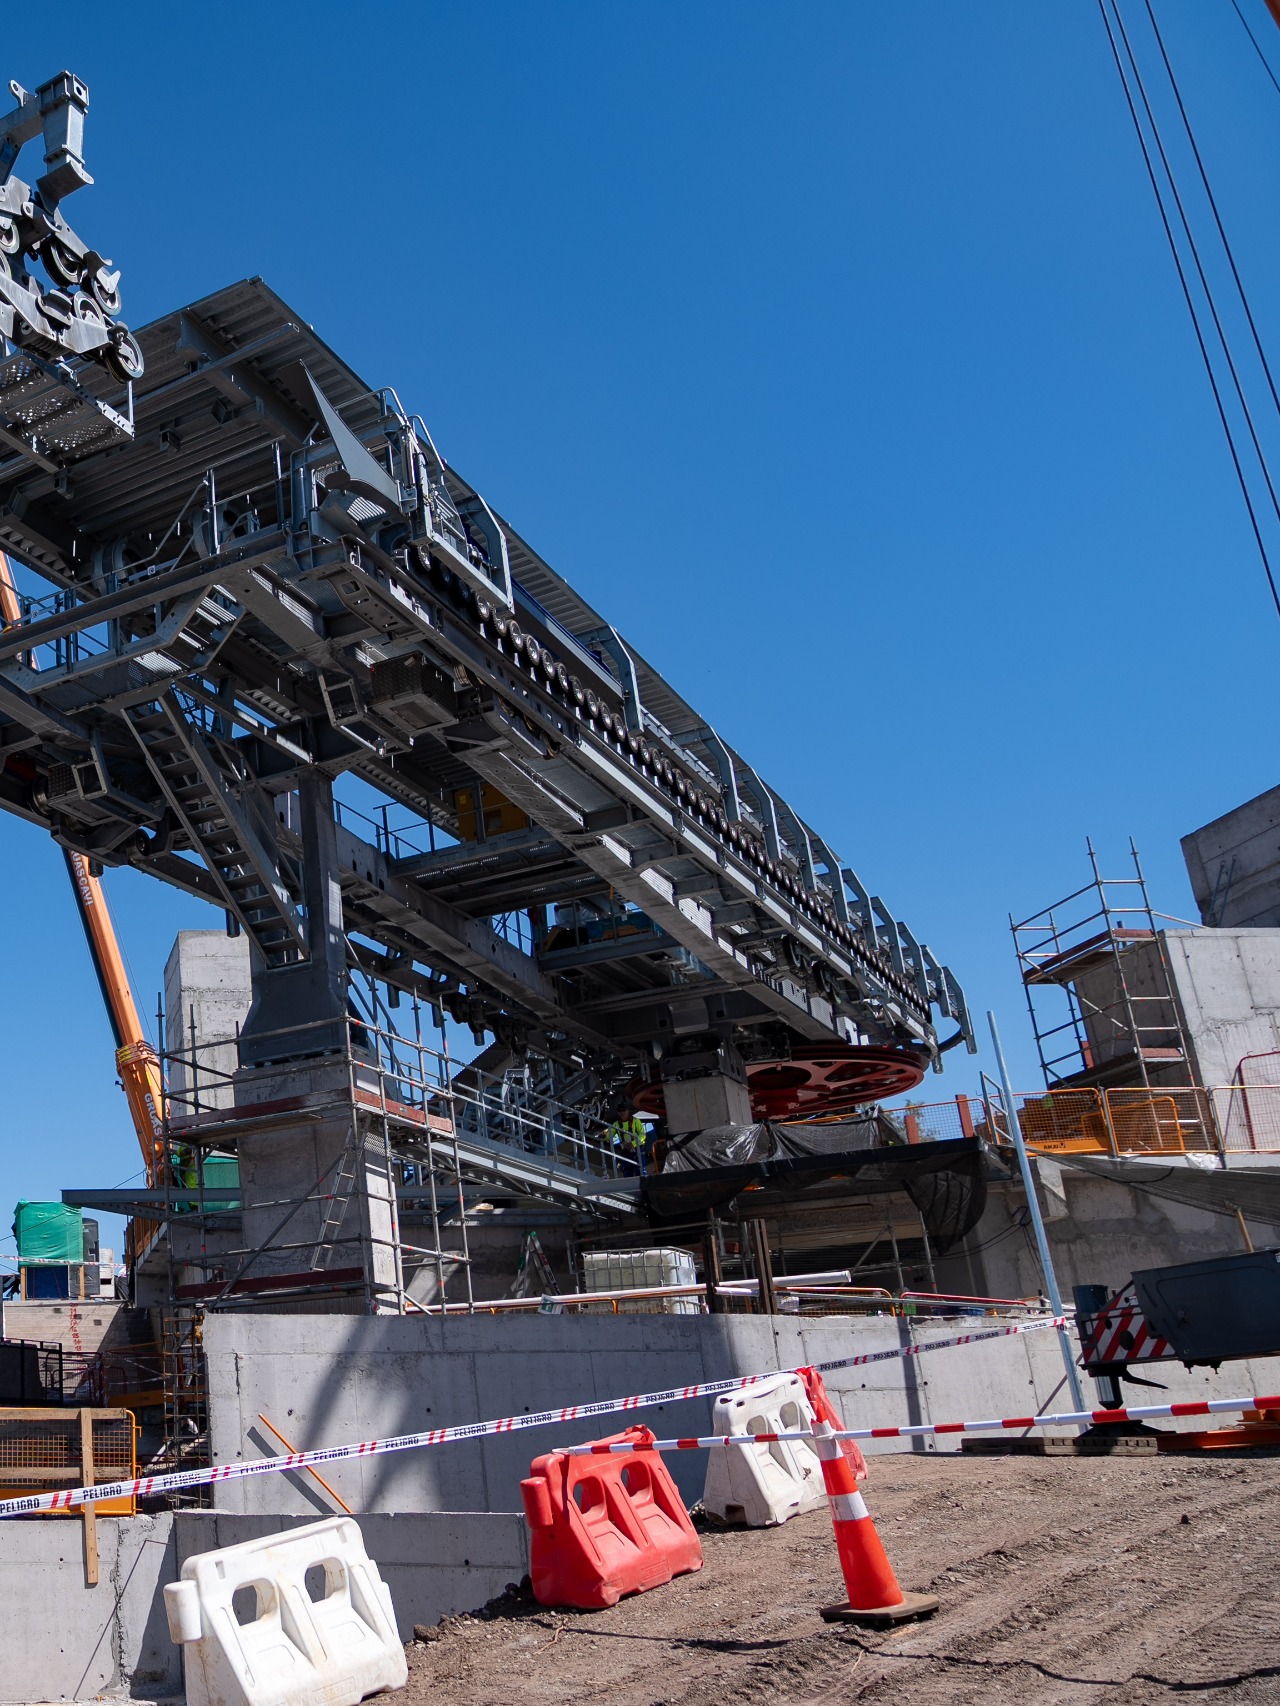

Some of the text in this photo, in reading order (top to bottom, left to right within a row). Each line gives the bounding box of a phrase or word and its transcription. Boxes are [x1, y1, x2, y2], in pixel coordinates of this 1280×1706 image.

[71, 850, 94, 906] UAS CAVI
[144, 1093, 163, 1136] GRUAS
[0, 1497, 40, 1514] PELIGRO
[83, 1485, 122, 1500] PELIGRO
